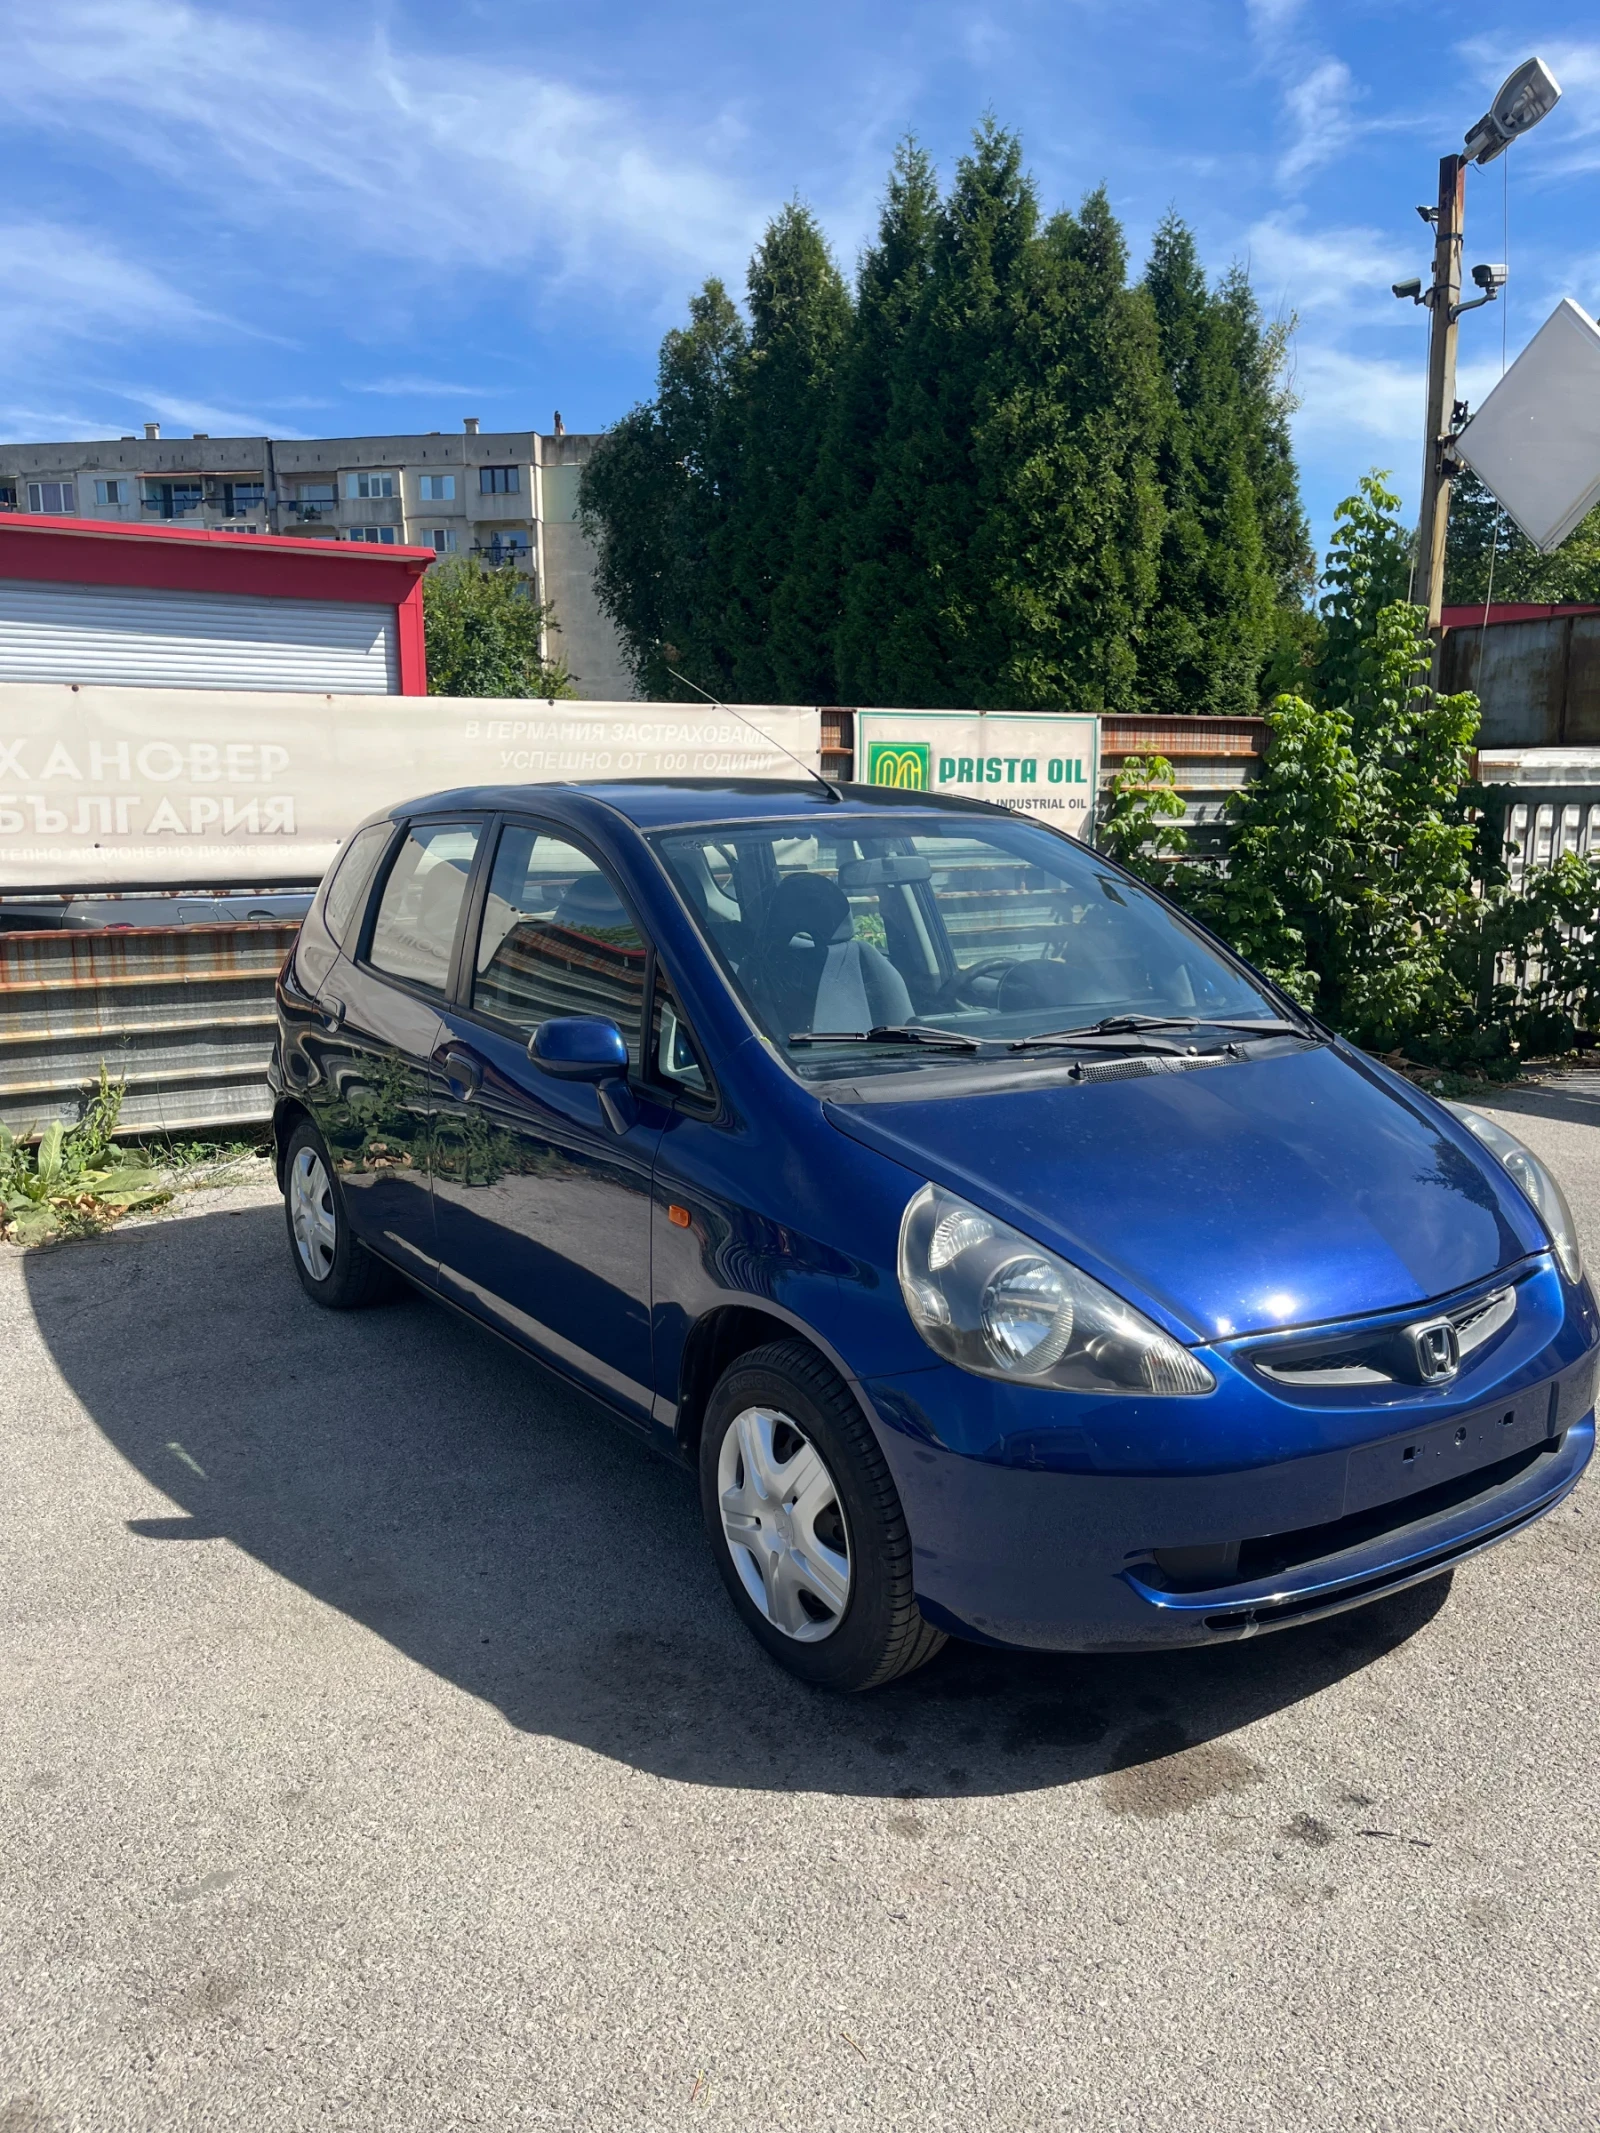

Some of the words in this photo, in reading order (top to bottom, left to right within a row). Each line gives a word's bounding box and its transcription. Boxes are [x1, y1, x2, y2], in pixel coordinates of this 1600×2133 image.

[465, 720, 481, 740] В
[487, 720, 605, 742] ГЕРМАНИЯ
[610, 722, 773, 745] ЗАСТРАХОВАМЕ
[0, 738, 290, 783] ХАНОВЕР
[499, 750, 613, 771] УСПЕШНО
[618, 751, 648, 770] ОТ
[654, 752, 687, 771] 100
[692, 753, 773, 773] ГОДИНИ
[939, 757, 1037, 783] PRISTA
[1047, 758, 1087, 784] OIL
[0, 794, 297, 836] БЪЛГАРИЯ
[996, 798, 1065, 809] INDUSTRIAL
[1069, 798, 1087, 809] OIL
[69, 844, 193, 863] АКЦИОНЕРНО
